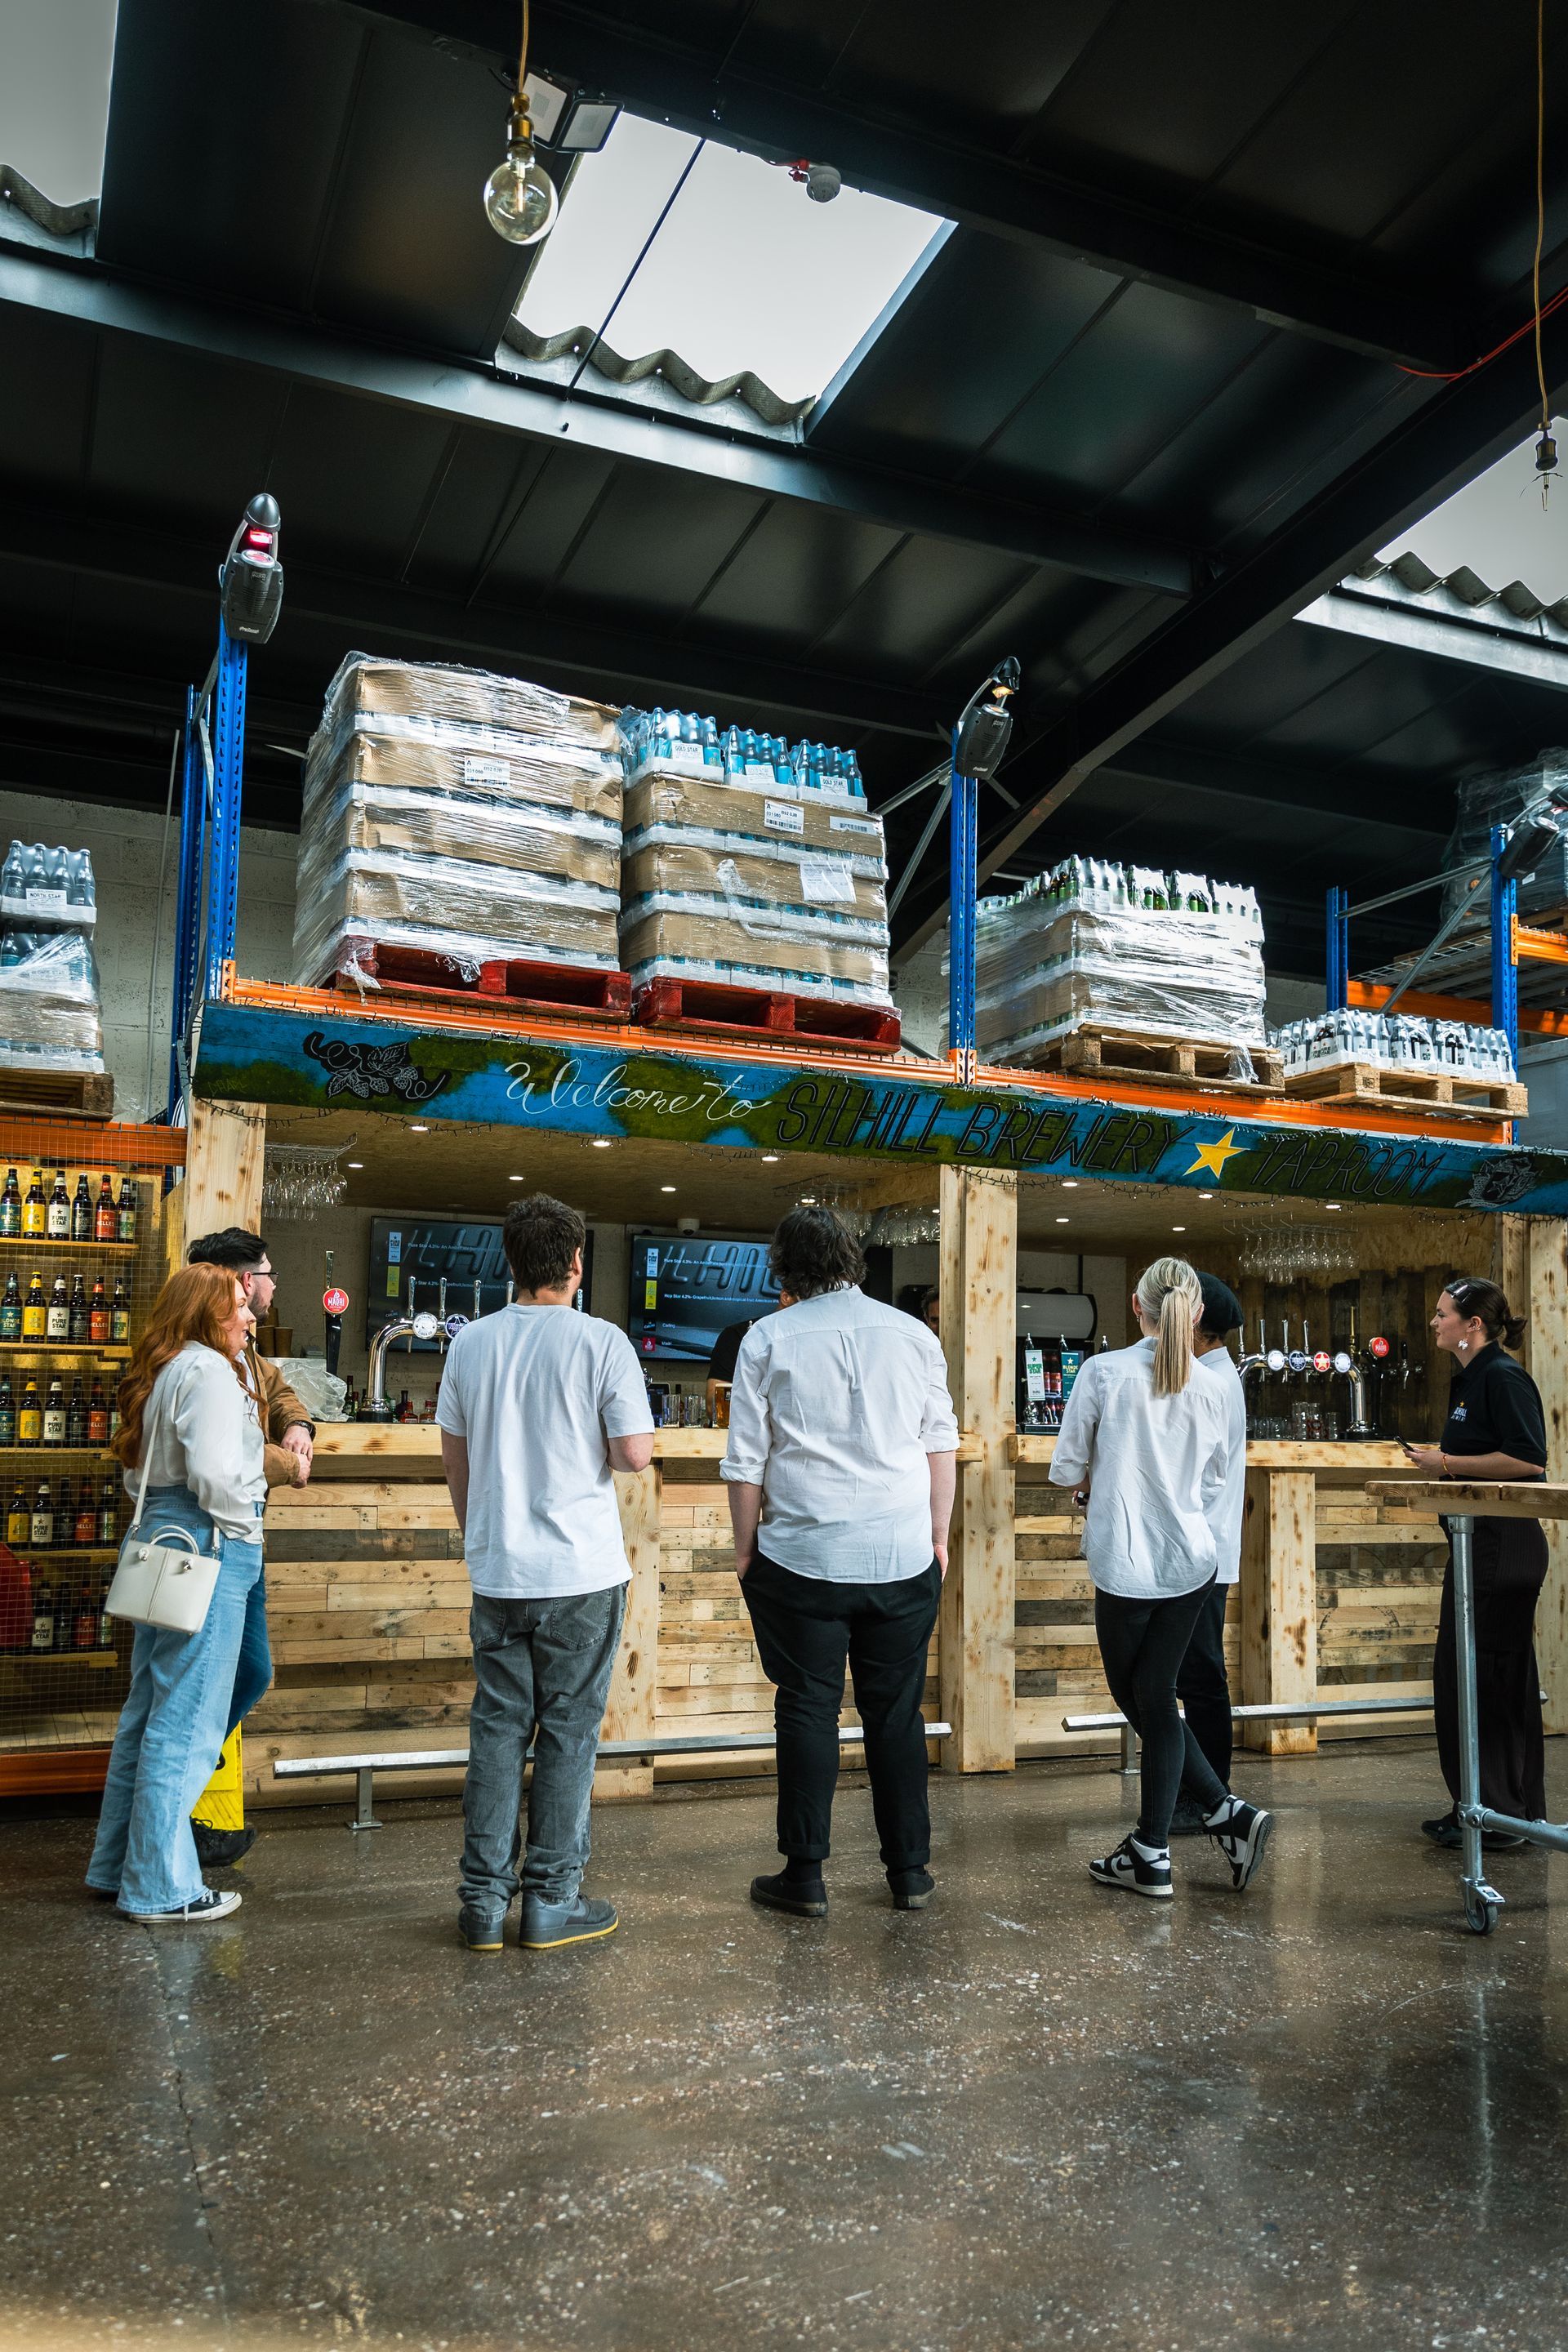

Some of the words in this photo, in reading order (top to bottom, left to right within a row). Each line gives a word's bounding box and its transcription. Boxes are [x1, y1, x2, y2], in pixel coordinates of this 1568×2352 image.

[505, 1058, 706, 1115] Welcome
[703, 1074, 773, 1120] to
[777, 1081, 946, 1155] SILHILL
[956, 1102, 1196, 1174] BREWERY
